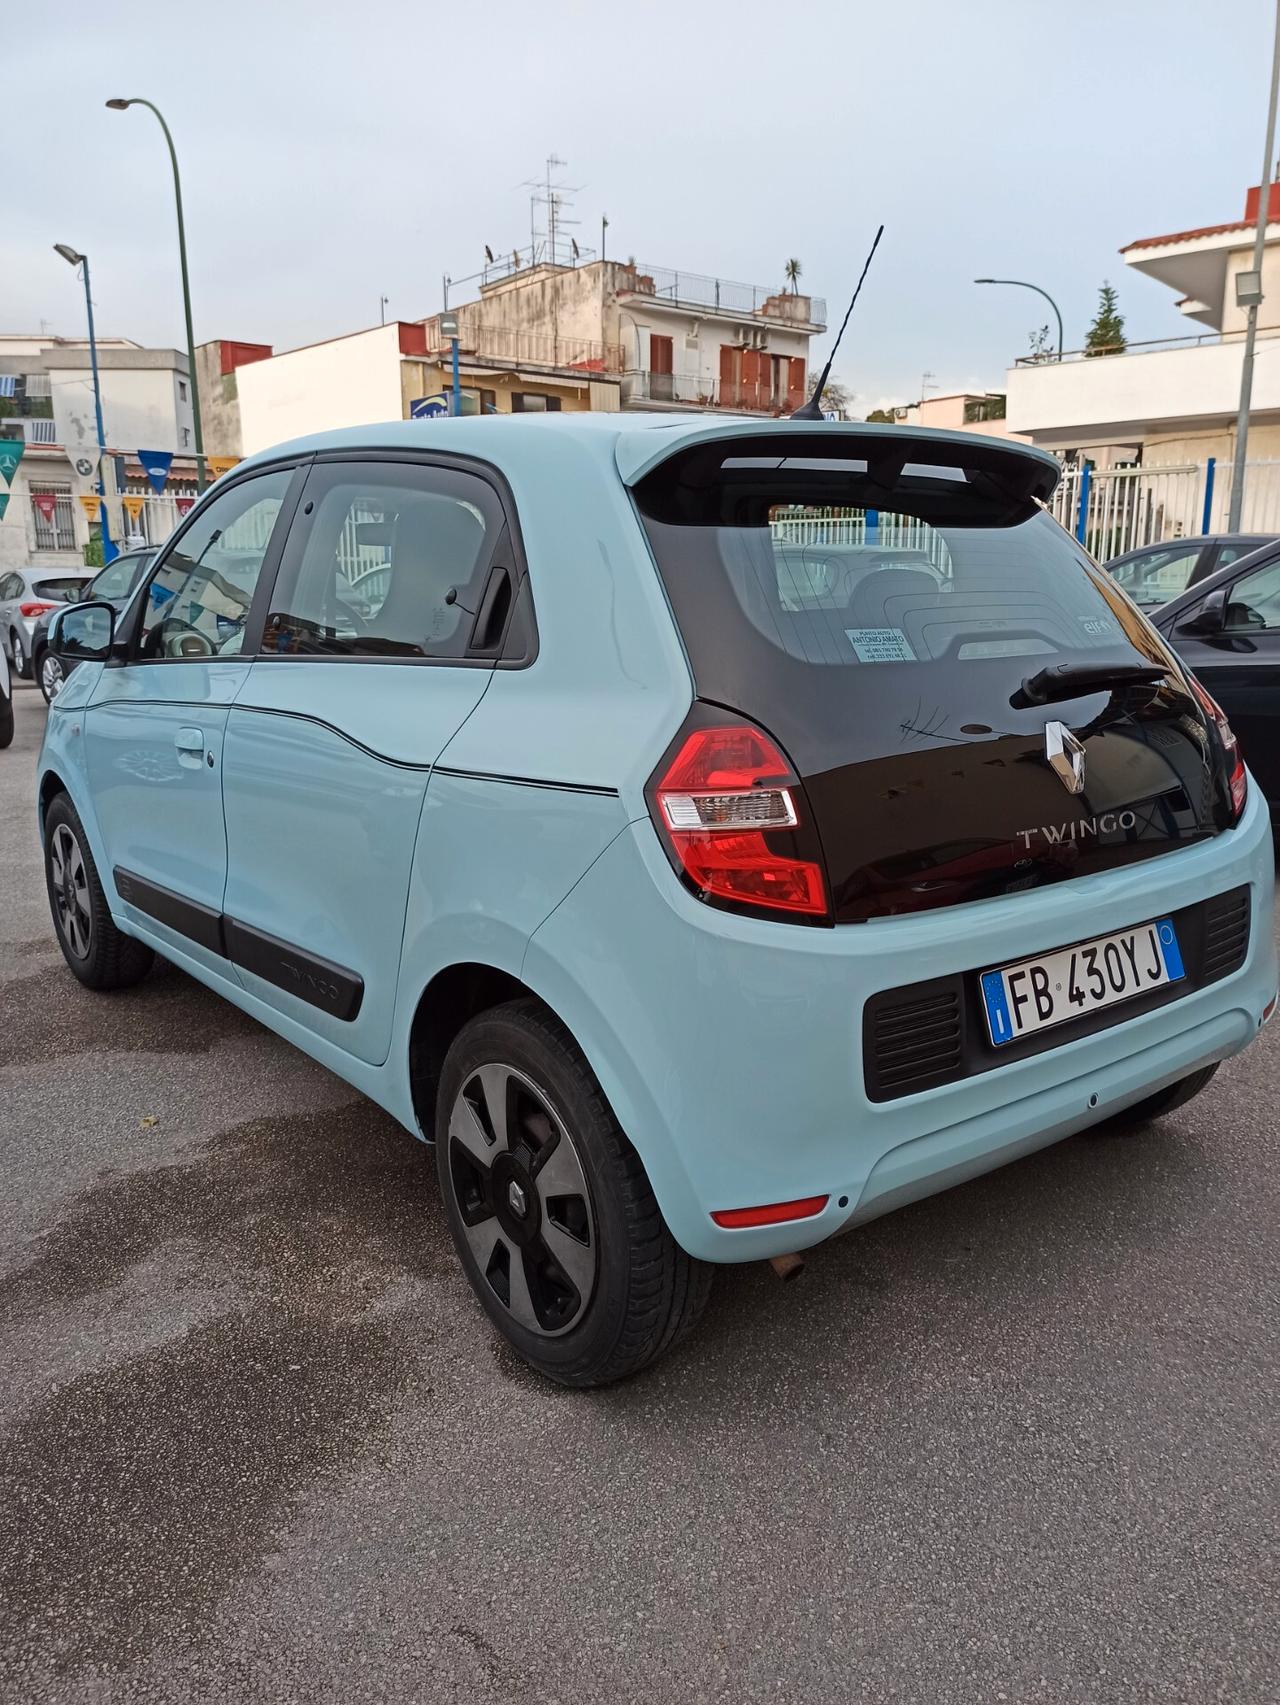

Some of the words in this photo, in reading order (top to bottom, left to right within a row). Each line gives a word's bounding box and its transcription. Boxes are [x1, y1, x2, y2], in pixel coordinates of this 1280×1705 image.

[851, 635, 882, 644] ANTONIO
[881, 635, 905, 643] AMATO
[1016, 810, 1136, 849] TWINGO
[1007, 965, 1055, 1030] FB
[1068, 929, 1163, 1007] 430YJ
